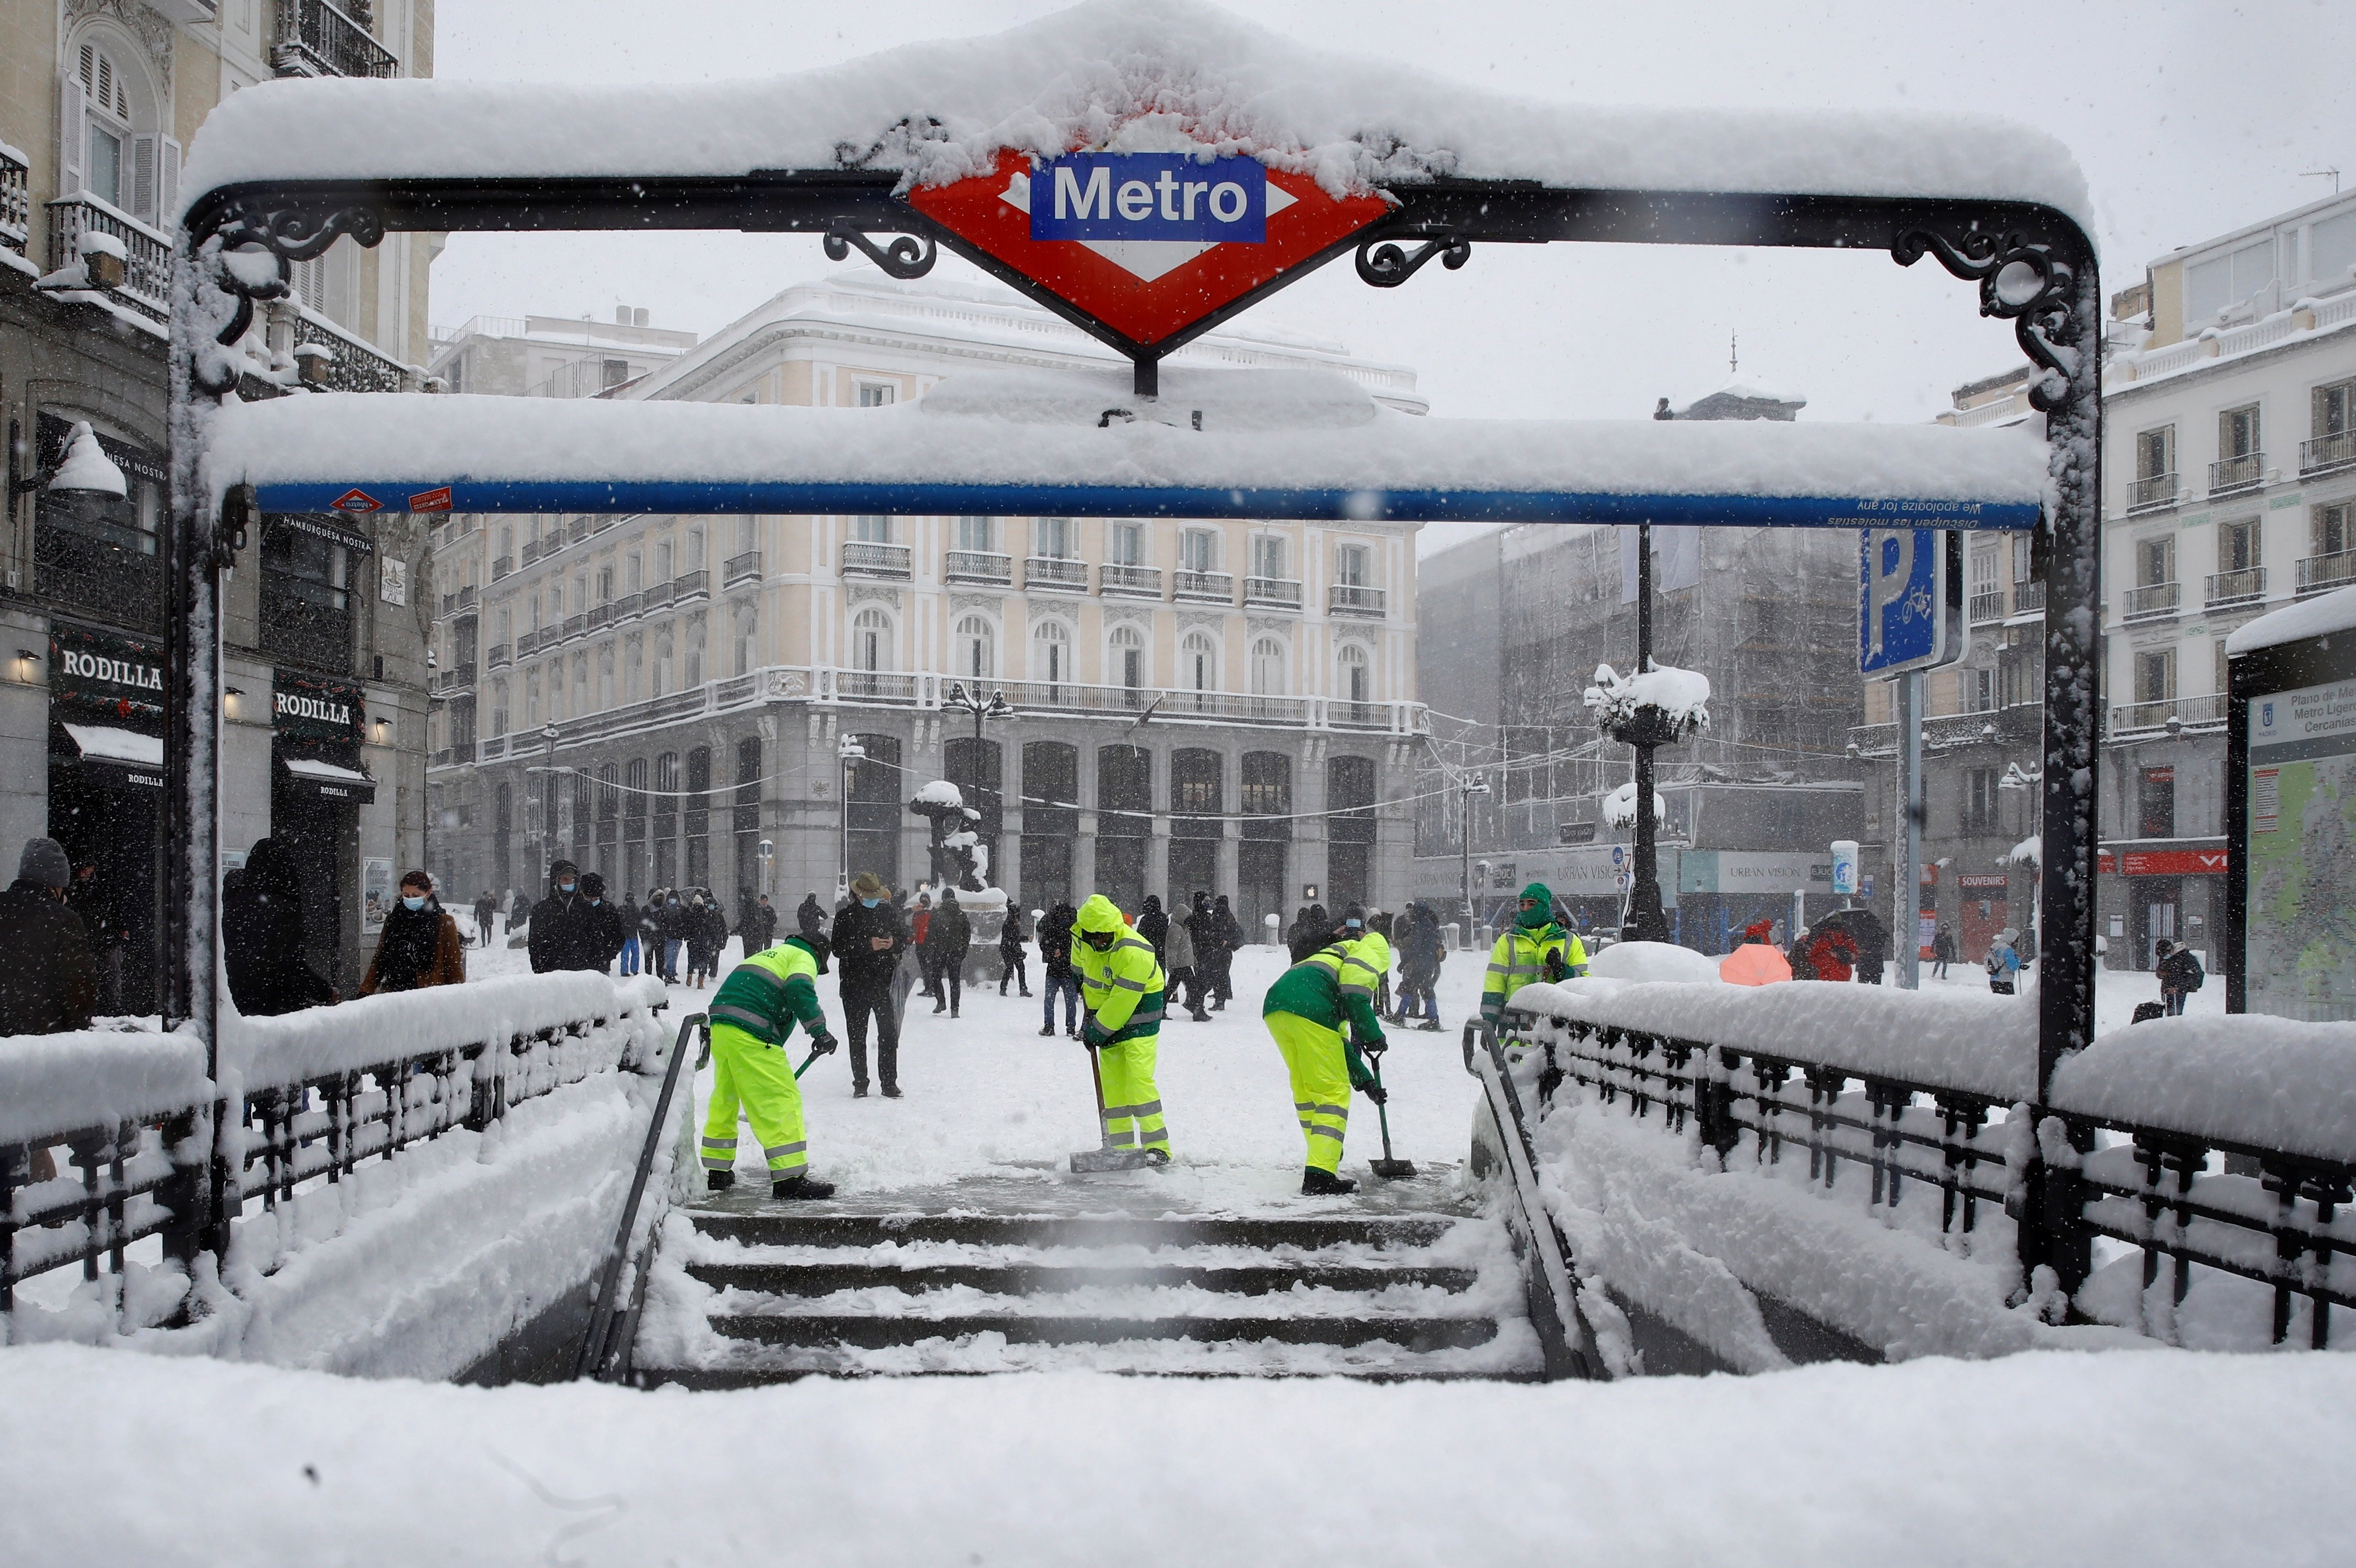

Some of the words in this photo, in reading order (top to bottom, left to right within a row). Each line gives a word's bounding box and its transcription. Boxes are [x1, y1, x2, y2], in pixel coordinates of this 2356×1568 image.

[1054, 167, 1248, 223] Metro
[345, 500, 369, 508] Metro
[1857, 500, 1879, 511] any
[1881, 501, 1898, 513] for
[1962, 502, 1981, 515] We
[1827, 517, 1889, 526] molestias
[1892, 517, 1912, 527] las
[1915, 516, 1979, 529] Disculpen
[283, 517, 341, 542] HAMBURGUESA
[343, 536, 373, 551] NOSTRA
[1869, 529, 1914, 661] P
[62, 649, 162, 691] RODILLA
[2291, 695, 2319, 706] Plano
[2322, 690, 2335, 702] de
[276, 692, 351, 725] RODILLA
[2294, 708, 2324, 720] Metro
[2305, 716, 2356, 733] Cercanías
[127, 774, 163, 787] RODILLA
[320, 787, 348, 797] RODILLA
[1558, 866, 1587, 880] URBAN
[1590, 865, 1615, 879] VISIO
[1730, 867, 1764, 877] URBAN
[1768, 867, 1801, 877] VISION
[1962, 876, 2005, 886] SOUVENIRS
